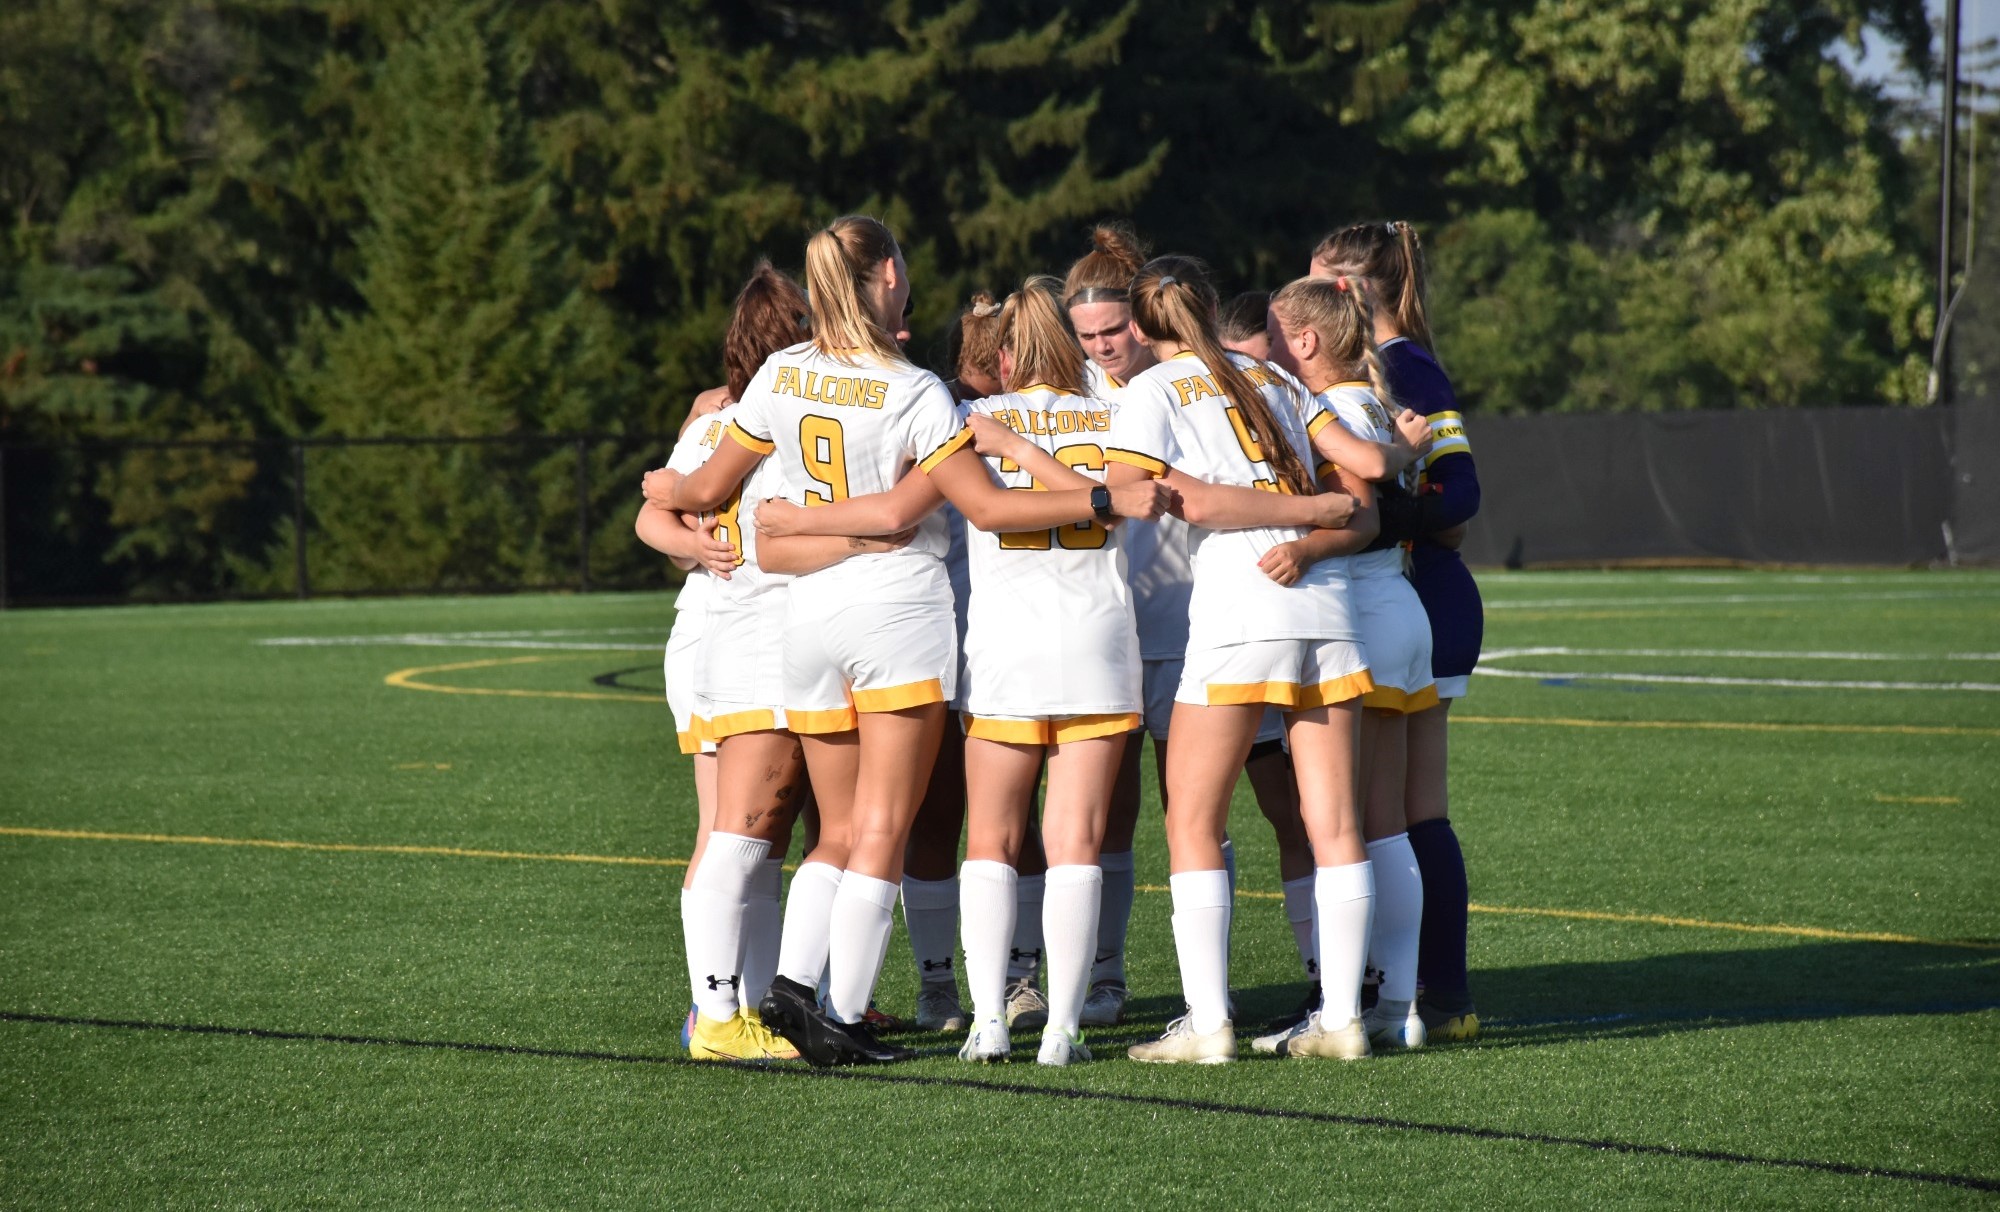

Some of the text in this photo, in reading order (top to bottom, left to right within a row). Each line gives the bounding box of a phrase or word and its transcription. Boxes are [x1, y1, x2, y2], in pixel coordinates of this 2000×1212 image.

[772, 366, 889, 409] FALCONS
[992, 409, 1110, 435] FALCONS
[799, 413, 849, 506] 9
